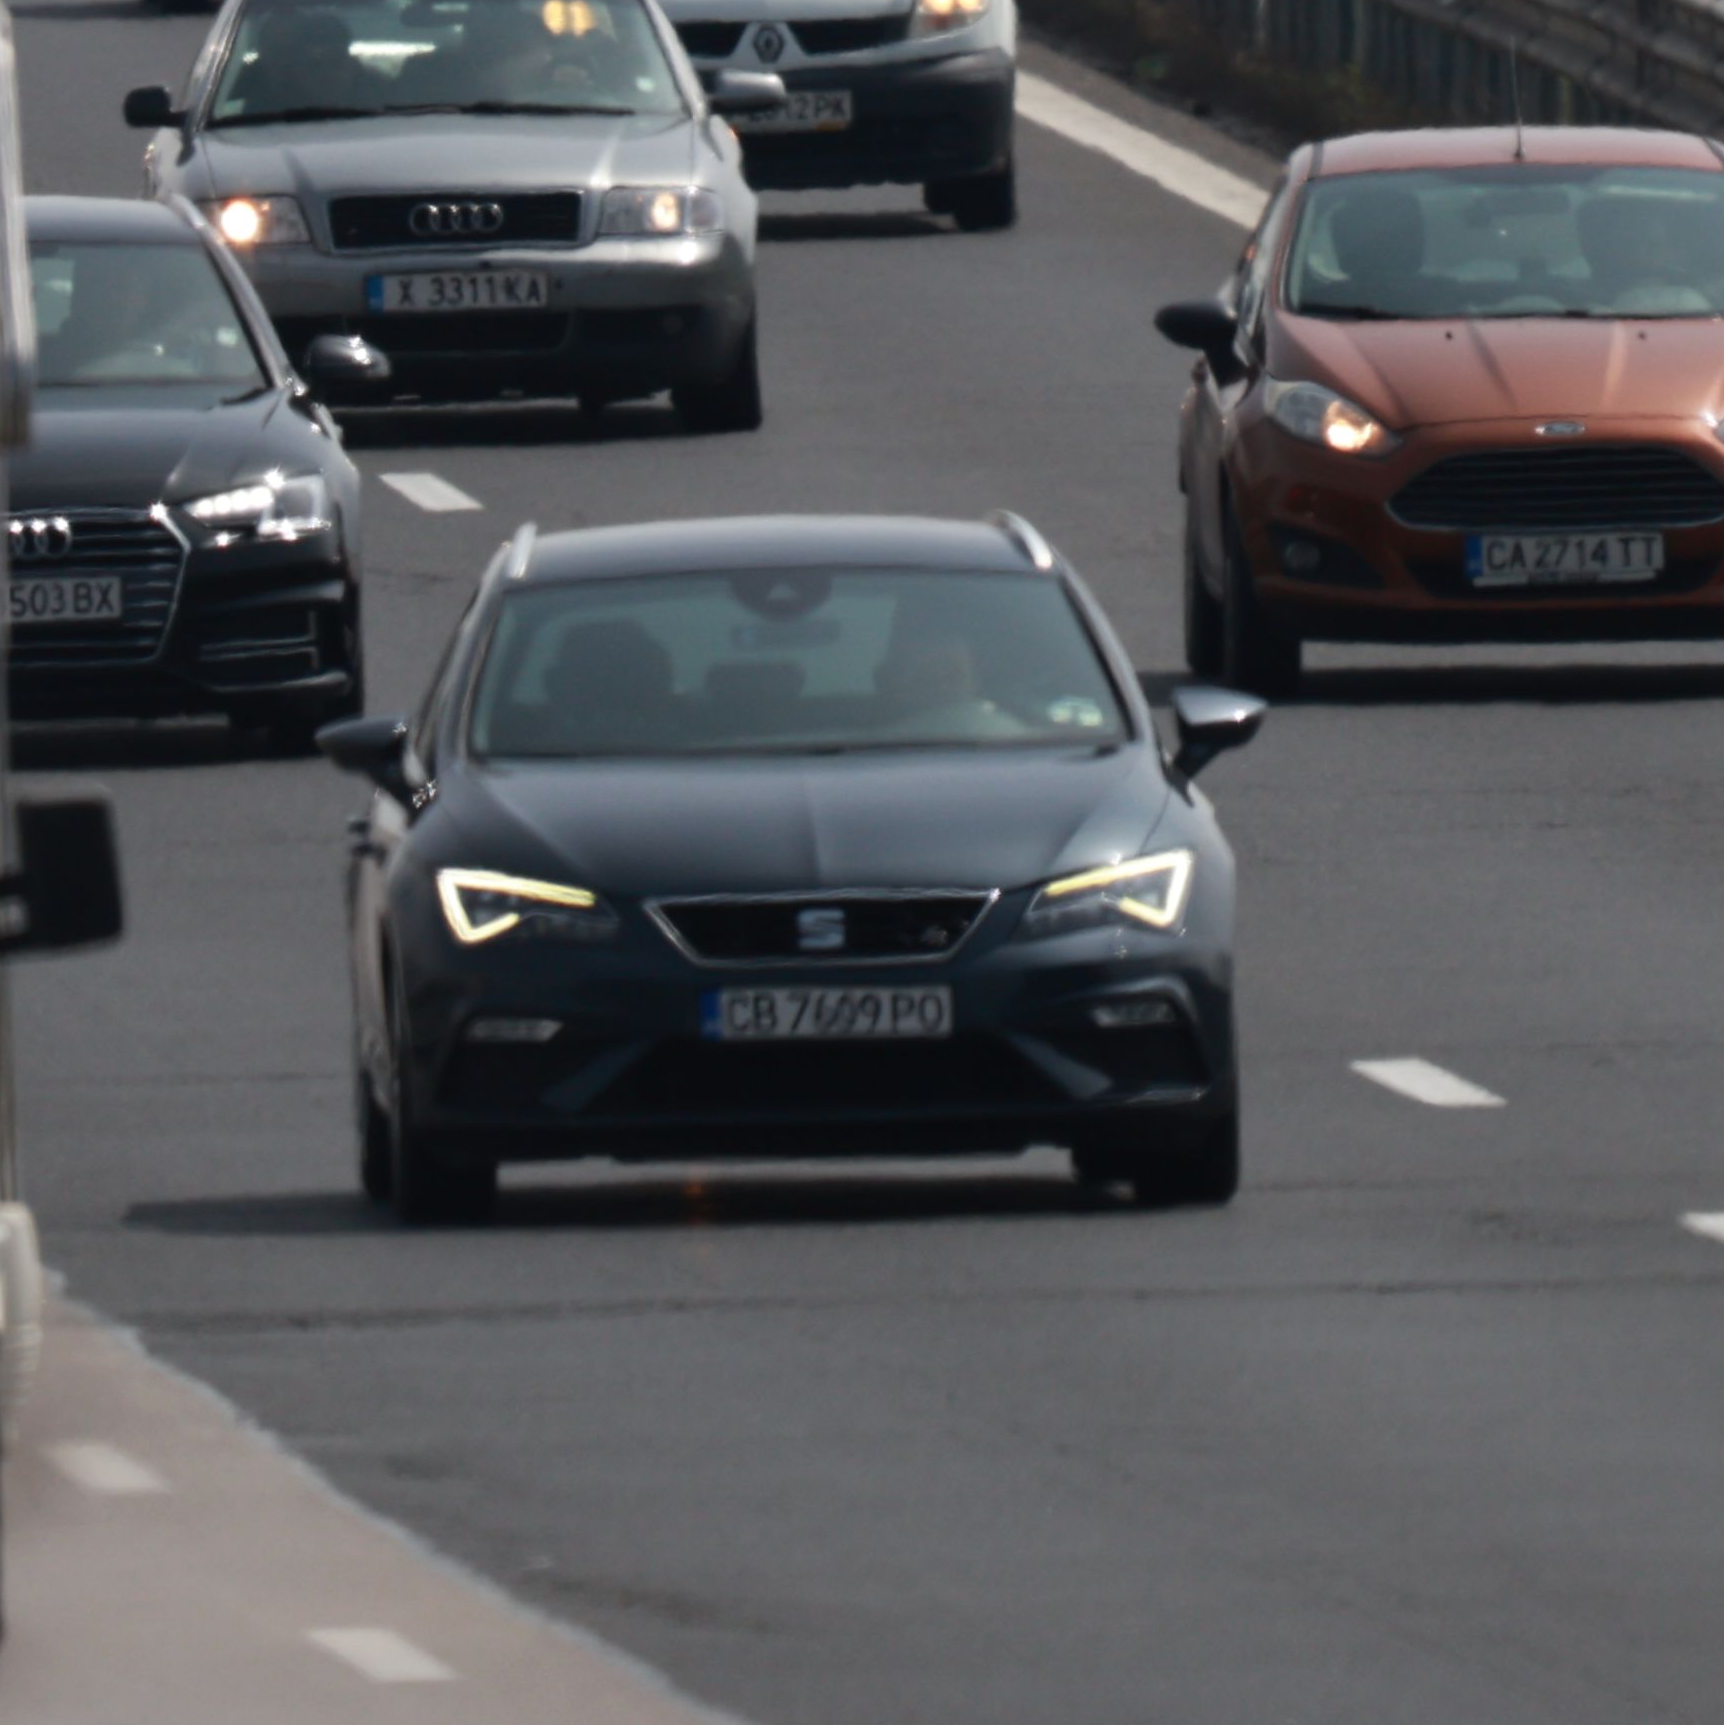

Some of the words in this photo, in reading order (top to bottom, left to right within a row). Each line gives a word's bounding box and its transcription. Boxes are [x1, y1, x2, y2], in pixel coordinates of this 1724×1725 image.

[1486, 539, 1526, 571] CA
[1534, 538, 1608, 572] 2714
[1617, 536, 1658, 568] TT
[73, 582, 115, 614] BX
[727, 992, 776, 1032] CB
[890, 992, 943, 1030] PO
